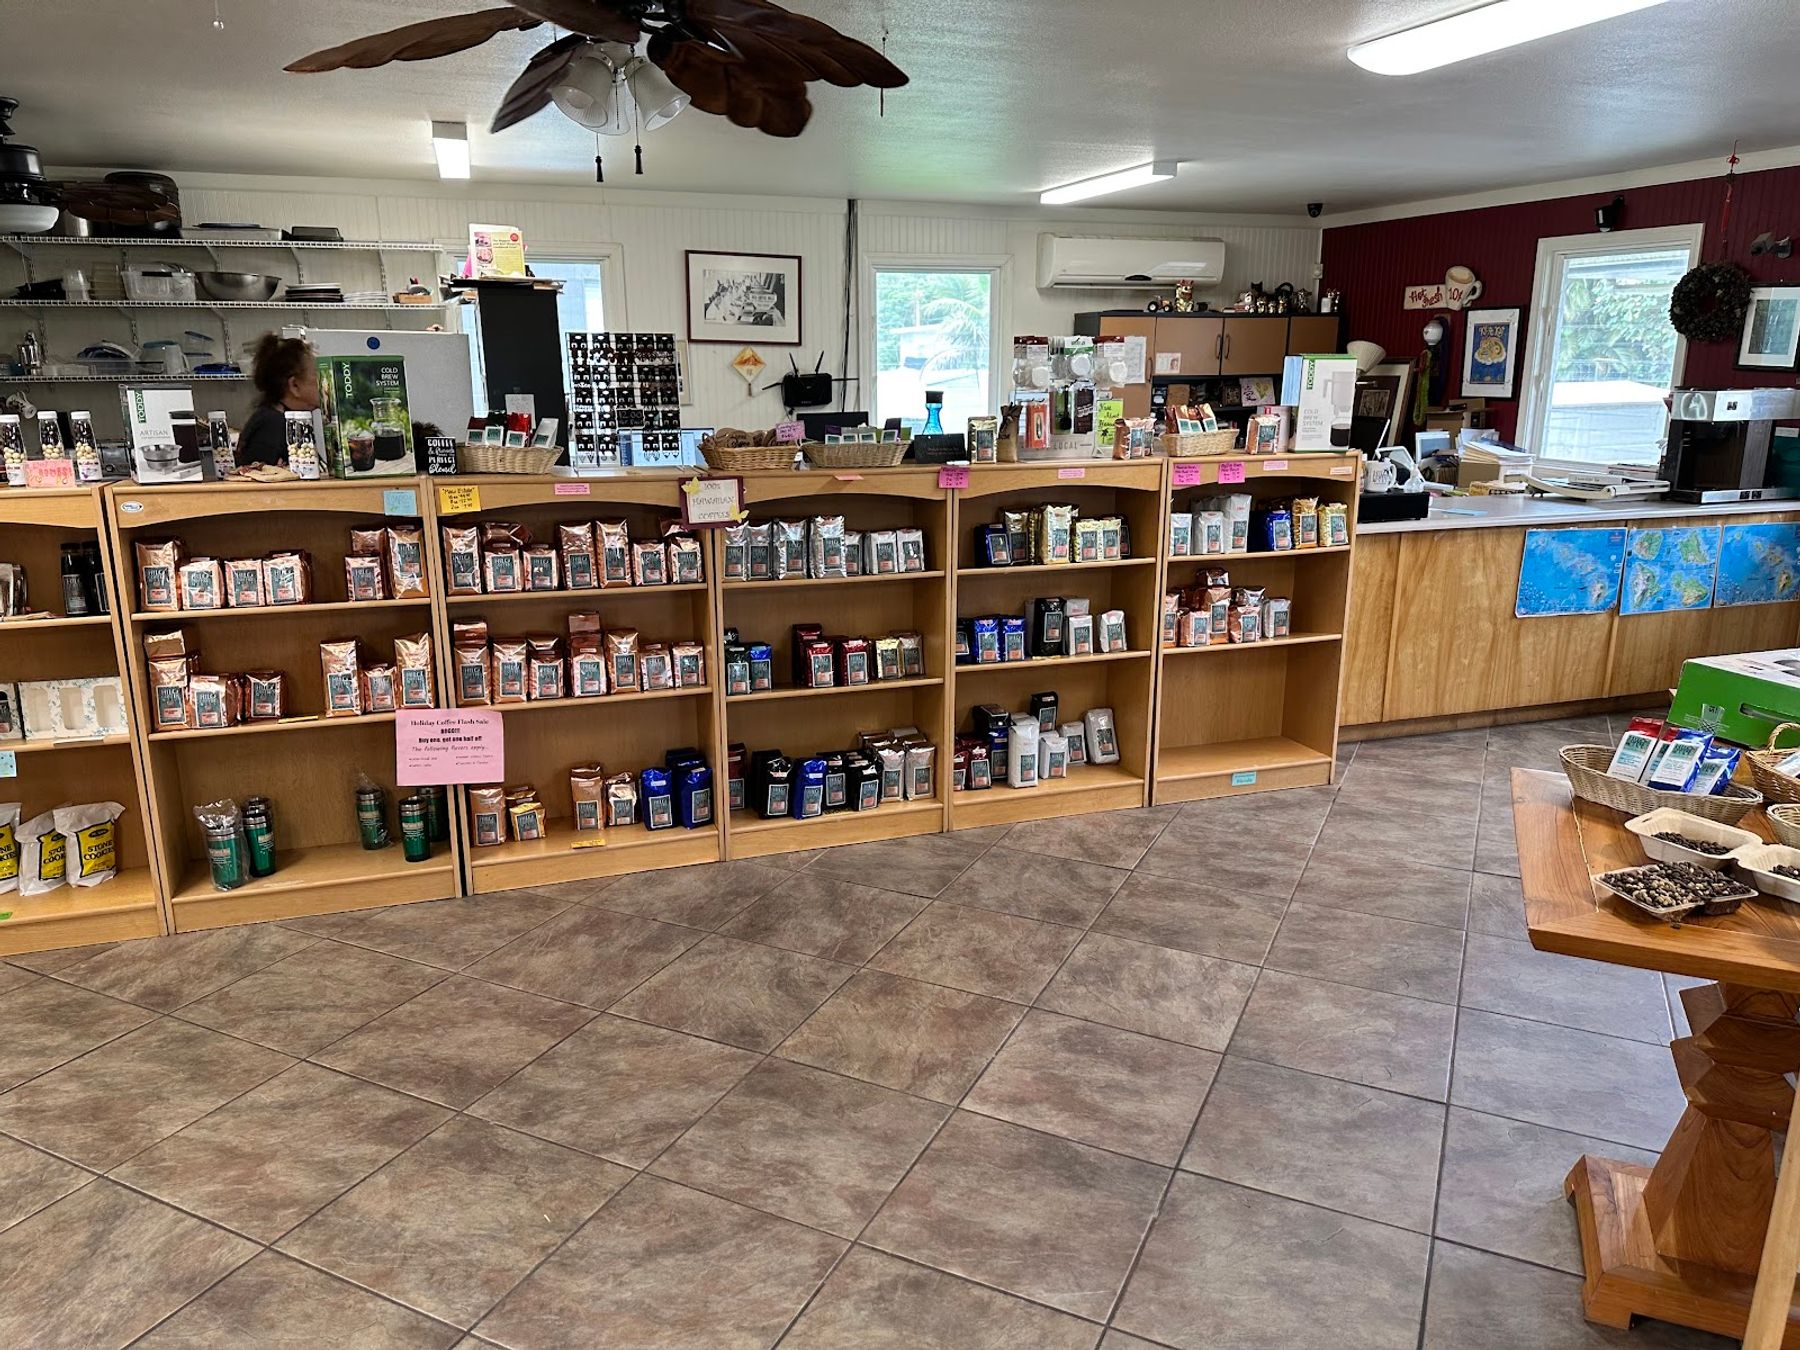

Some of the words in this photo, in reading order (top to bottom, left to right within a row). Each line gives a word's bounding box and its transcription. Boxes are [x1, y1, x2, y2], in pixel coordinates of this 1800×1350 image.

[343, 363, 354, 398] TODDY
[1307, 360, 1315, 390] TODDY
[135, 391, 147, 423] TODDY
[410, 719, 435, 727] Holiday
[424, 745, 449, 753] following
[88, 840, 113, 852] STONE
